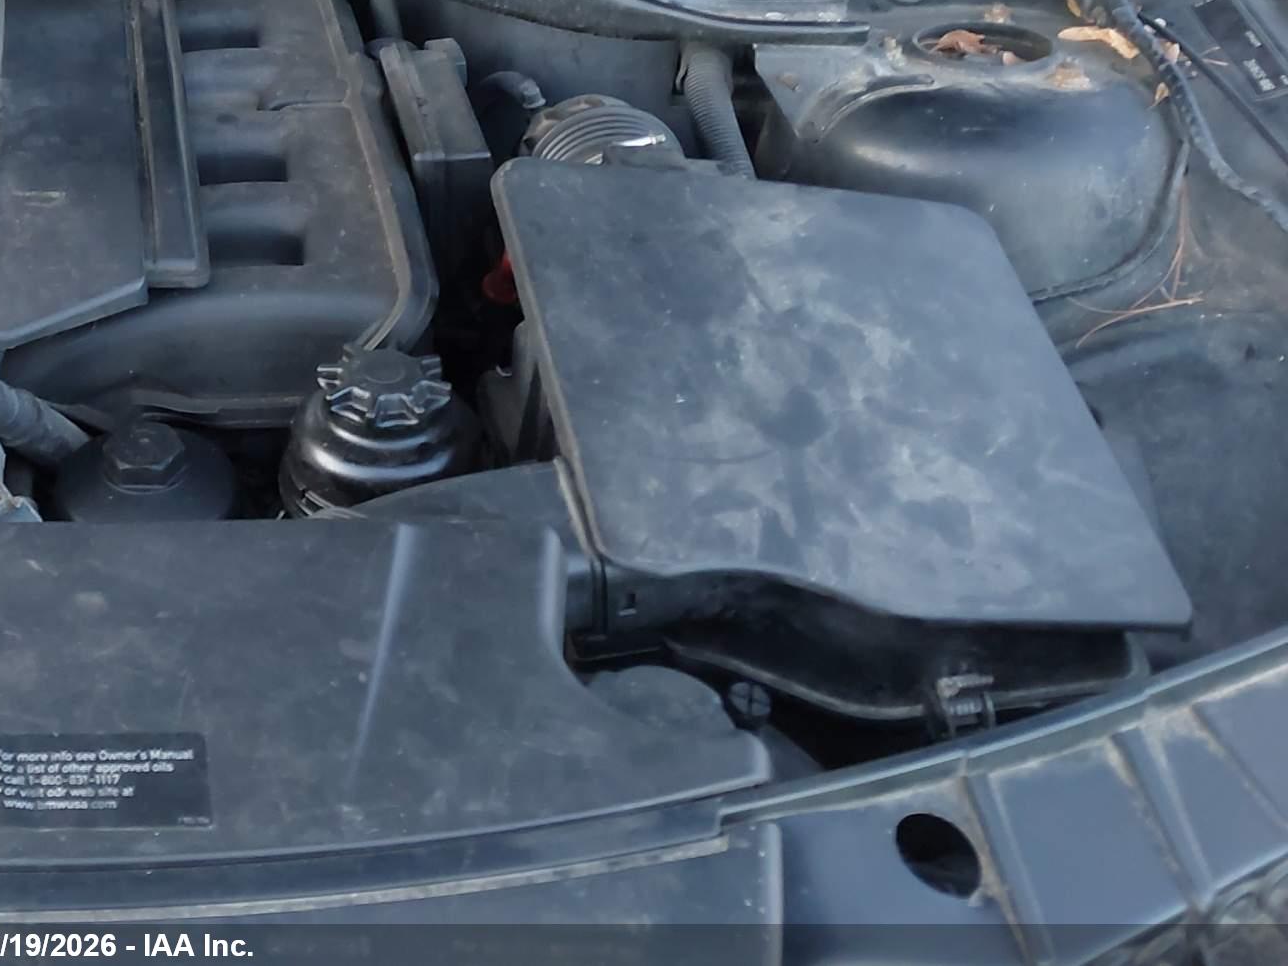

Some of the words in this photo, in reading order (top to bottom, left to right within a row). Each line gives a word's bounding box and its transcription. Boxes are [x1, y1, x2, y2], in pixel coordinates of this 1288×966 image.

[16, 752, 48, 762] more
[51, 750, 73, 762] info
[76, 752, 97, 761] see
[99, 750, 147, 761] Owner's
[150, 749, 194, 760] Manual
[26, 762, 46, 773] list
[48, 762, 61, 773] of
[62, 762, 94, 773] other
[95, 762, 150, 775] approved
[152, 762, 175, 773] oils
[3, 788, 18, 797] or
[69, 787, 96, 798] web
